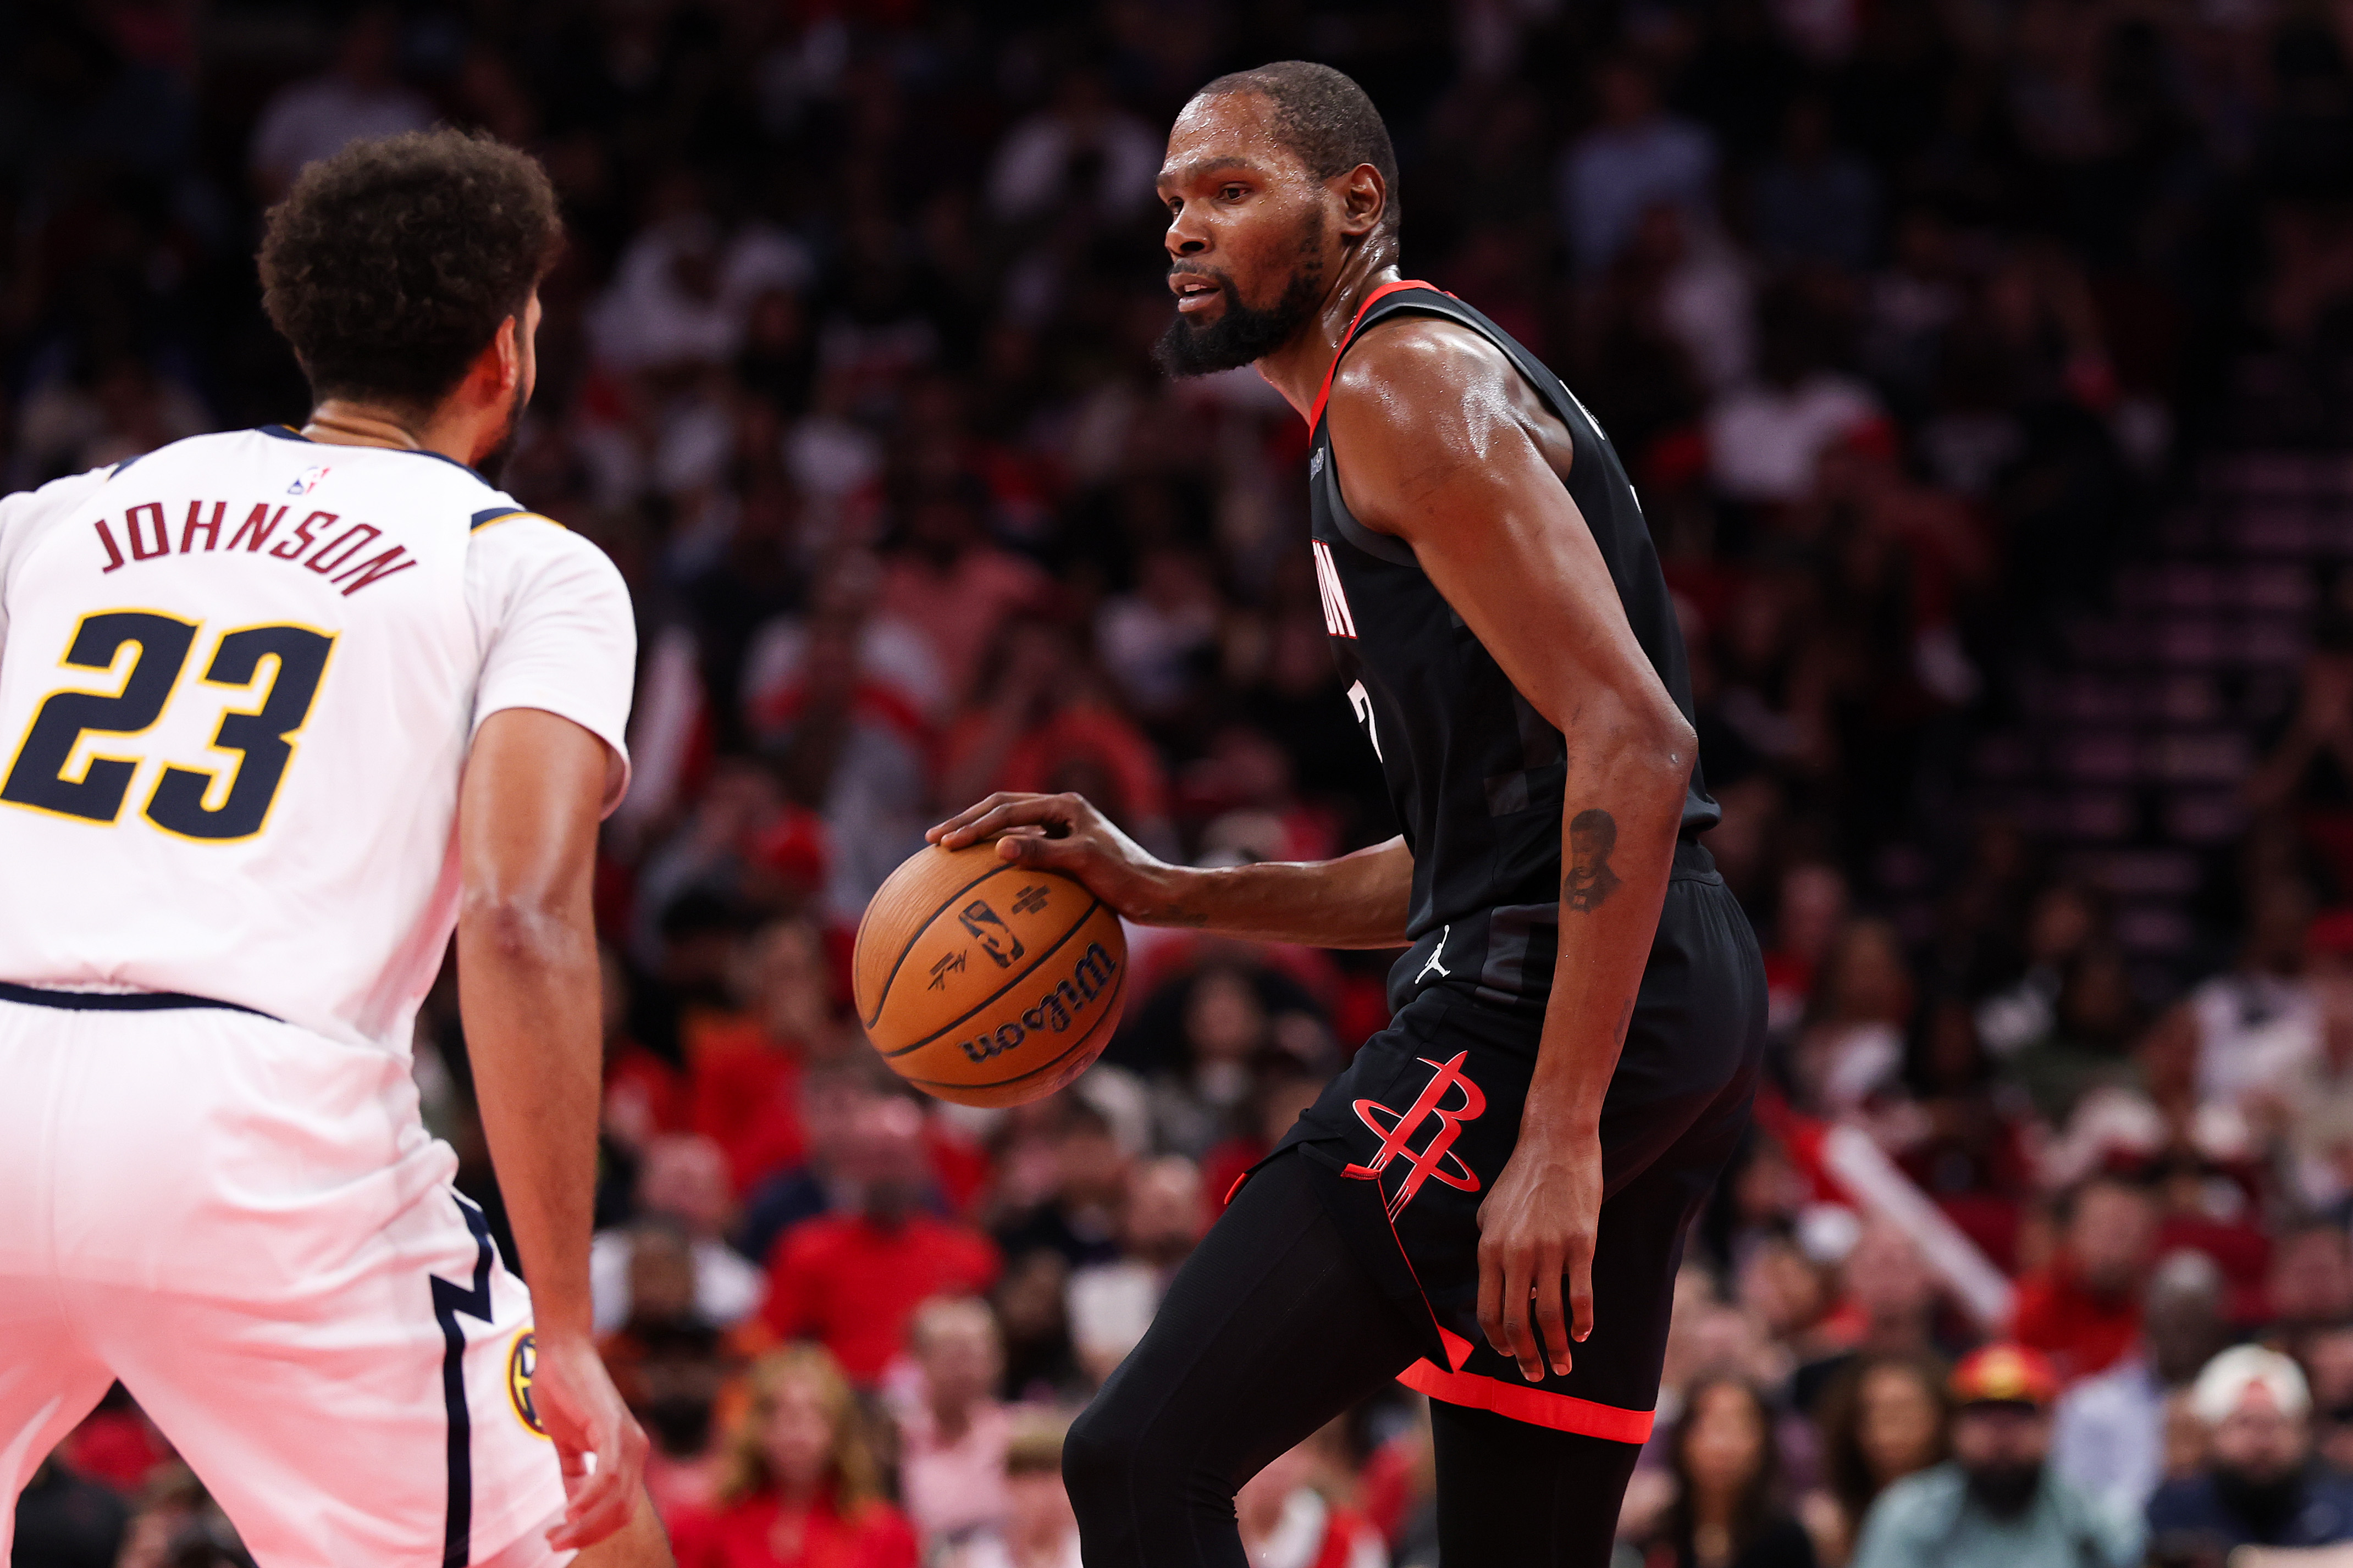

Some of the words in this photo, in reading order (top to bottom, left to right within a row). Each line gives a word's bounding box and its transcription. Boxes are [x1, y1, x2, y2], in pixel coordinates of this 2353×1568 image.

[95, 501, 417, 596] JOHNSON
[0, 607, 341, 845] 23
[1346, 679, 1383, 764] 7
[957, 941, 1117, 1064] Wilson
